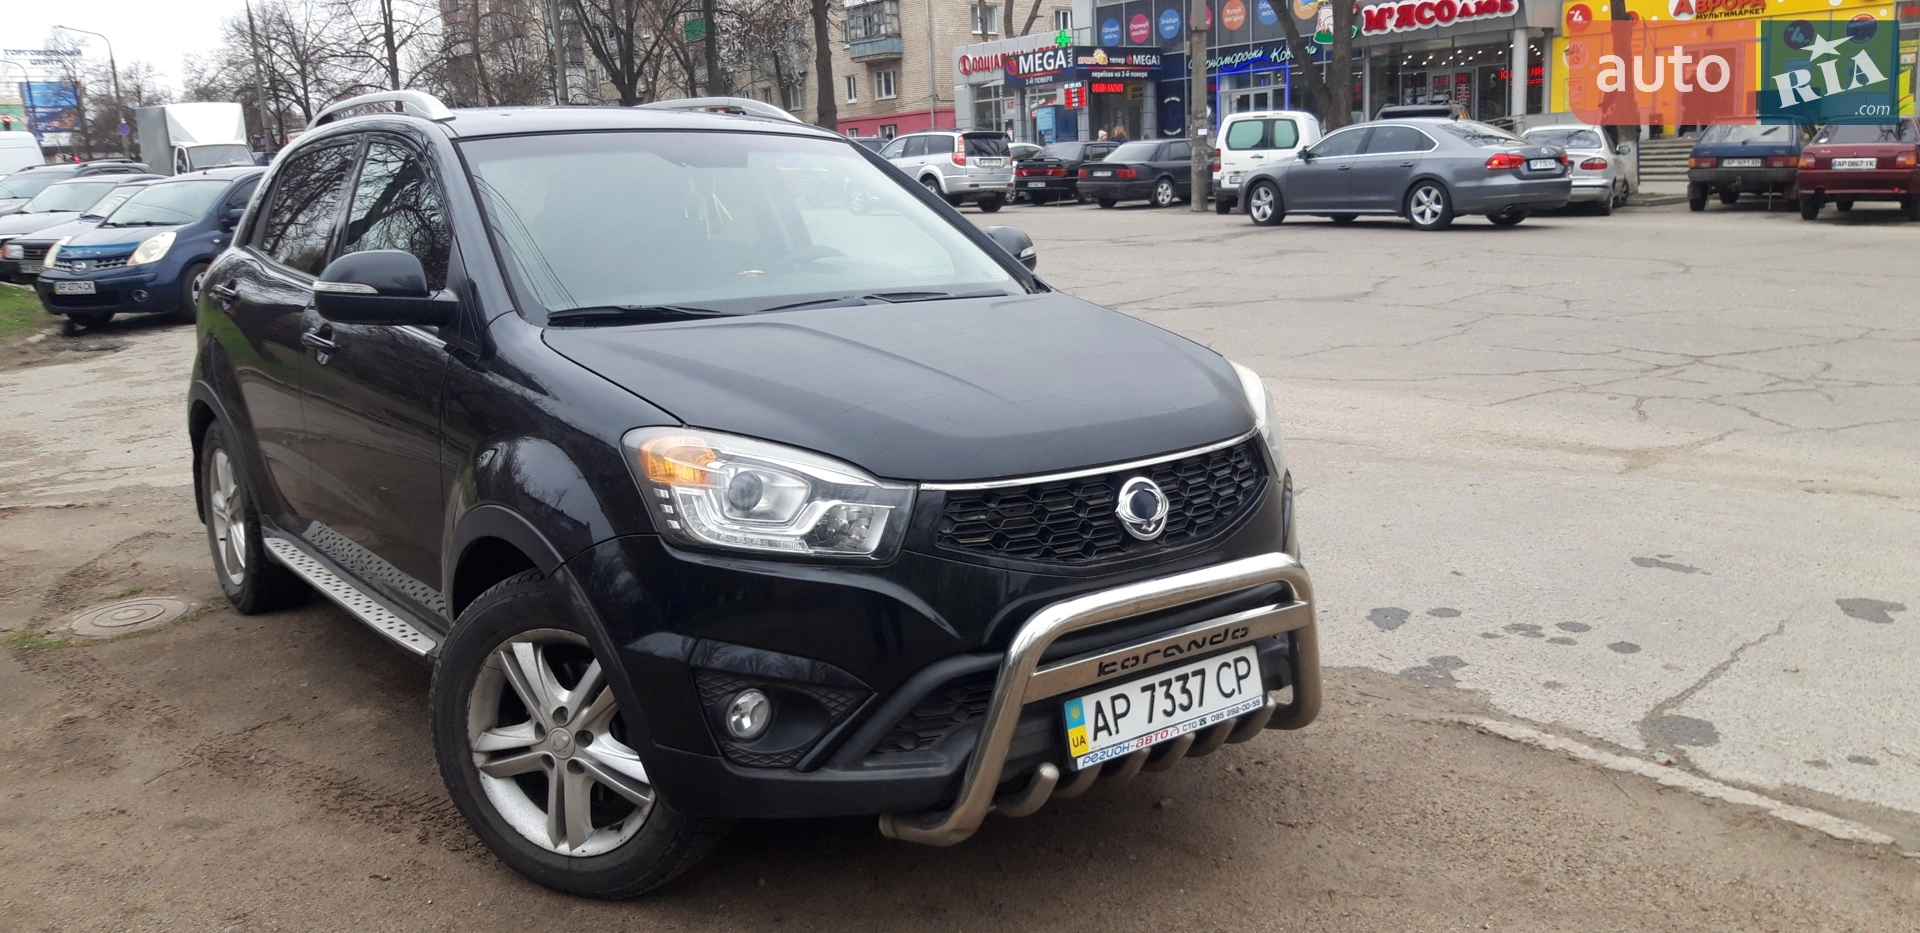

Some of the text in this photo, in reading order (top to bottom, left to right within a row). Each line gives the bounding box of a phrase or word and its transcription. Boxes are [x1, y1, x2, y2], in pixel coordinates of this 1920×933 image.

[1696, 8, 1766, 20] МУЛЬТИМАРКЕТ
[1019, 50, 1067, 75] MEGA
[1132, 55, 1157, 65] MEGA
[1034, 76, 1053, 85] ПОВЕРХ
[1091, 71, 1114, 79] переїхав
[1092, 656, 1252, 741] AP 7337 CP
[1210, 713, 1225, 722] 095
[1072, 735, 1087, 748] UA
